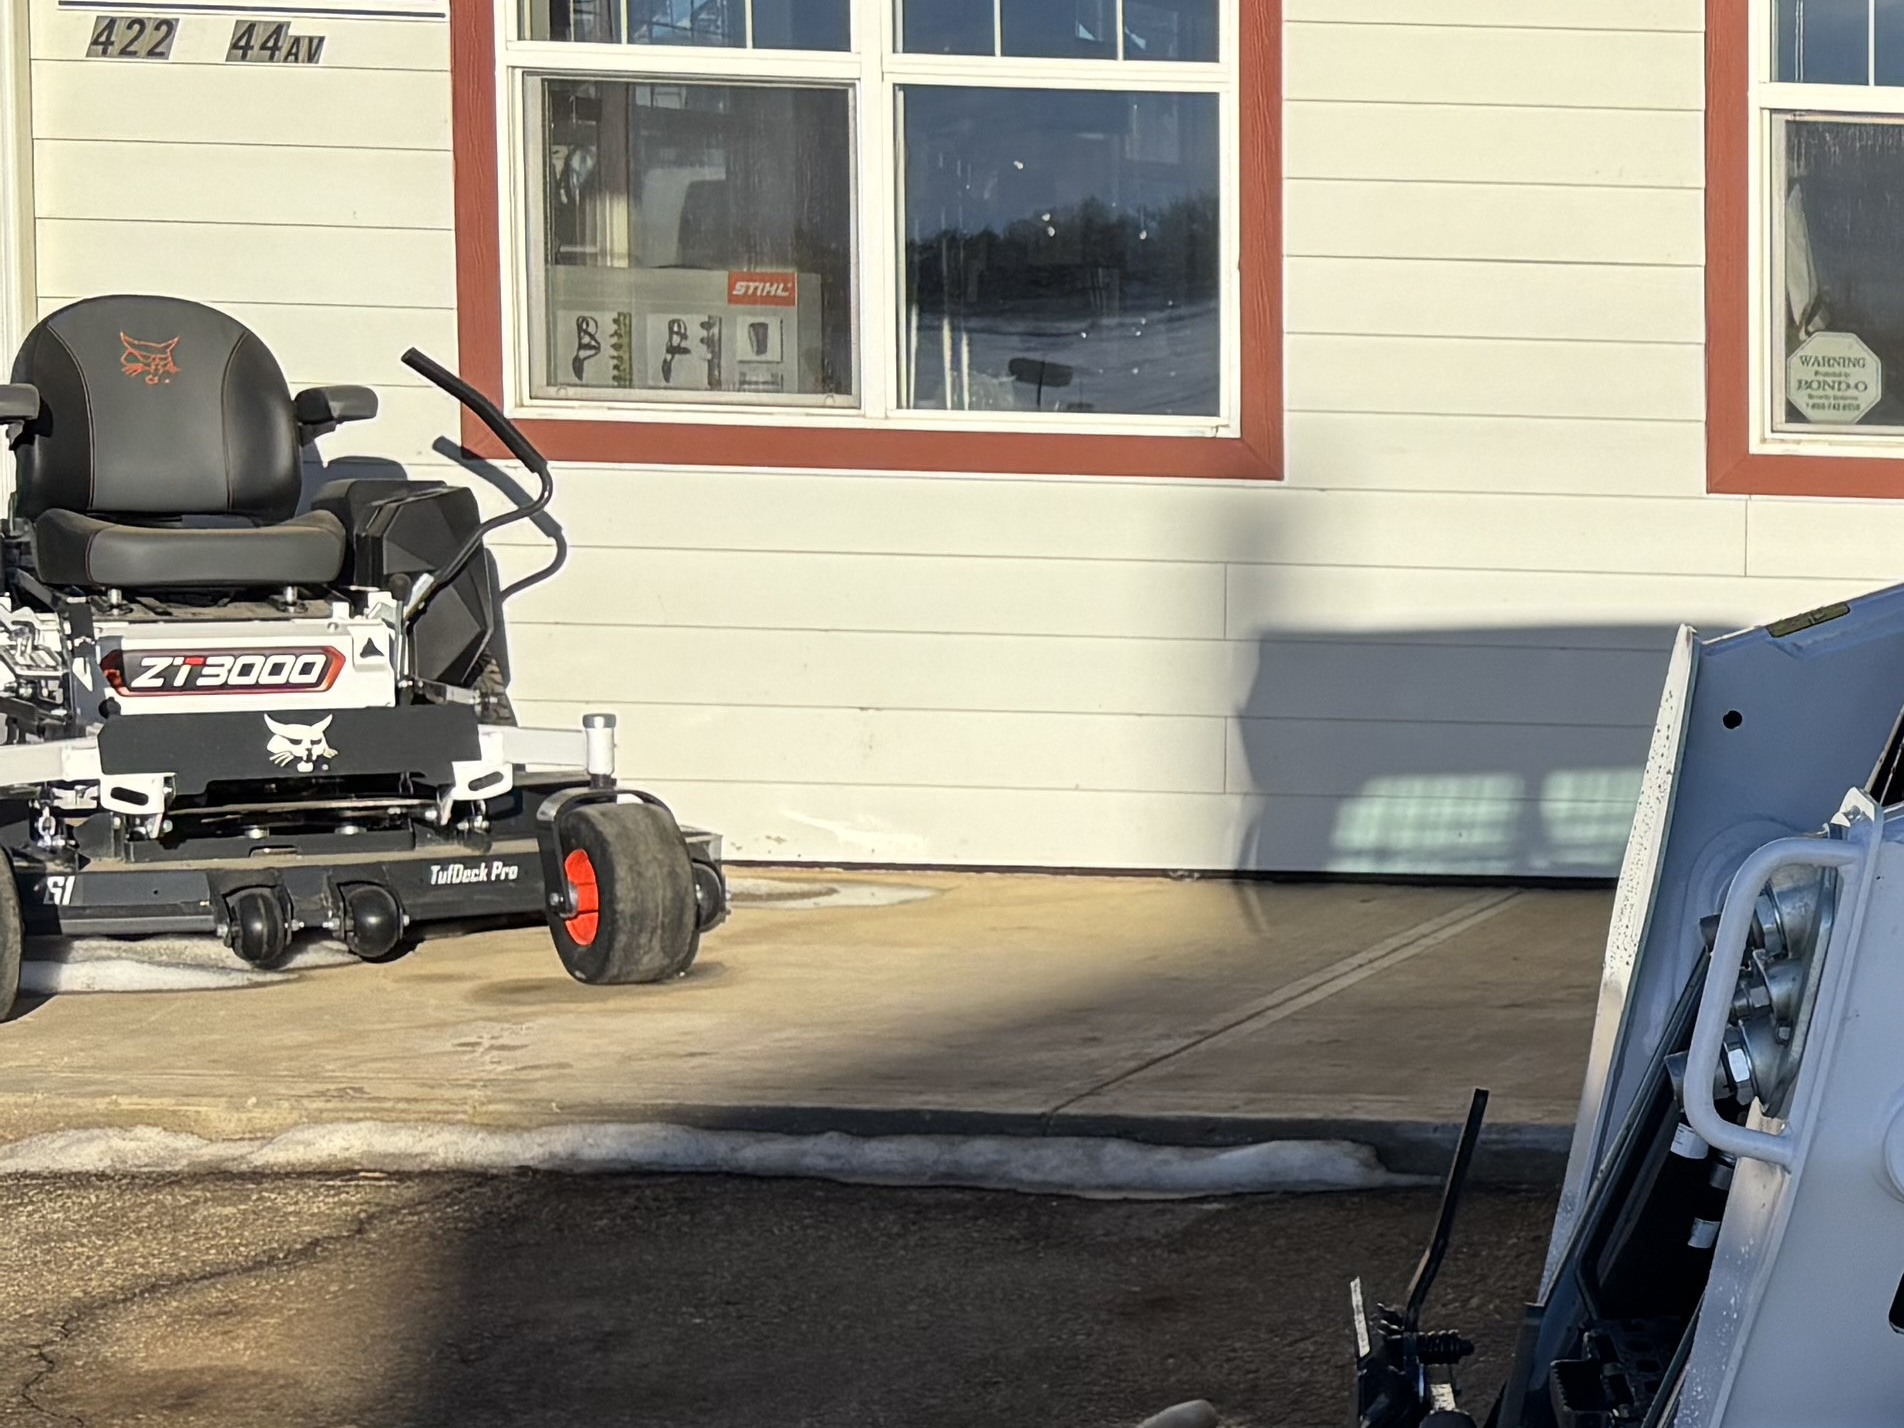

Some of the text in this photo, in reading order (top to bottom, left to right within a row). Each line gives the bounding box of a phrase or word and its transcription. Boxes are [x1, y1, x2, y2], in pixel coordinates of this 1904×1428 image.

[90, 18, 174, 58] 422
[732, 280, 790, 298] STIHL
[1799, 354, 1866, 369] WARNING
[130, 653, 328, 688] ZT3000
[430, 860, 518, 885] TufDeck Pro
